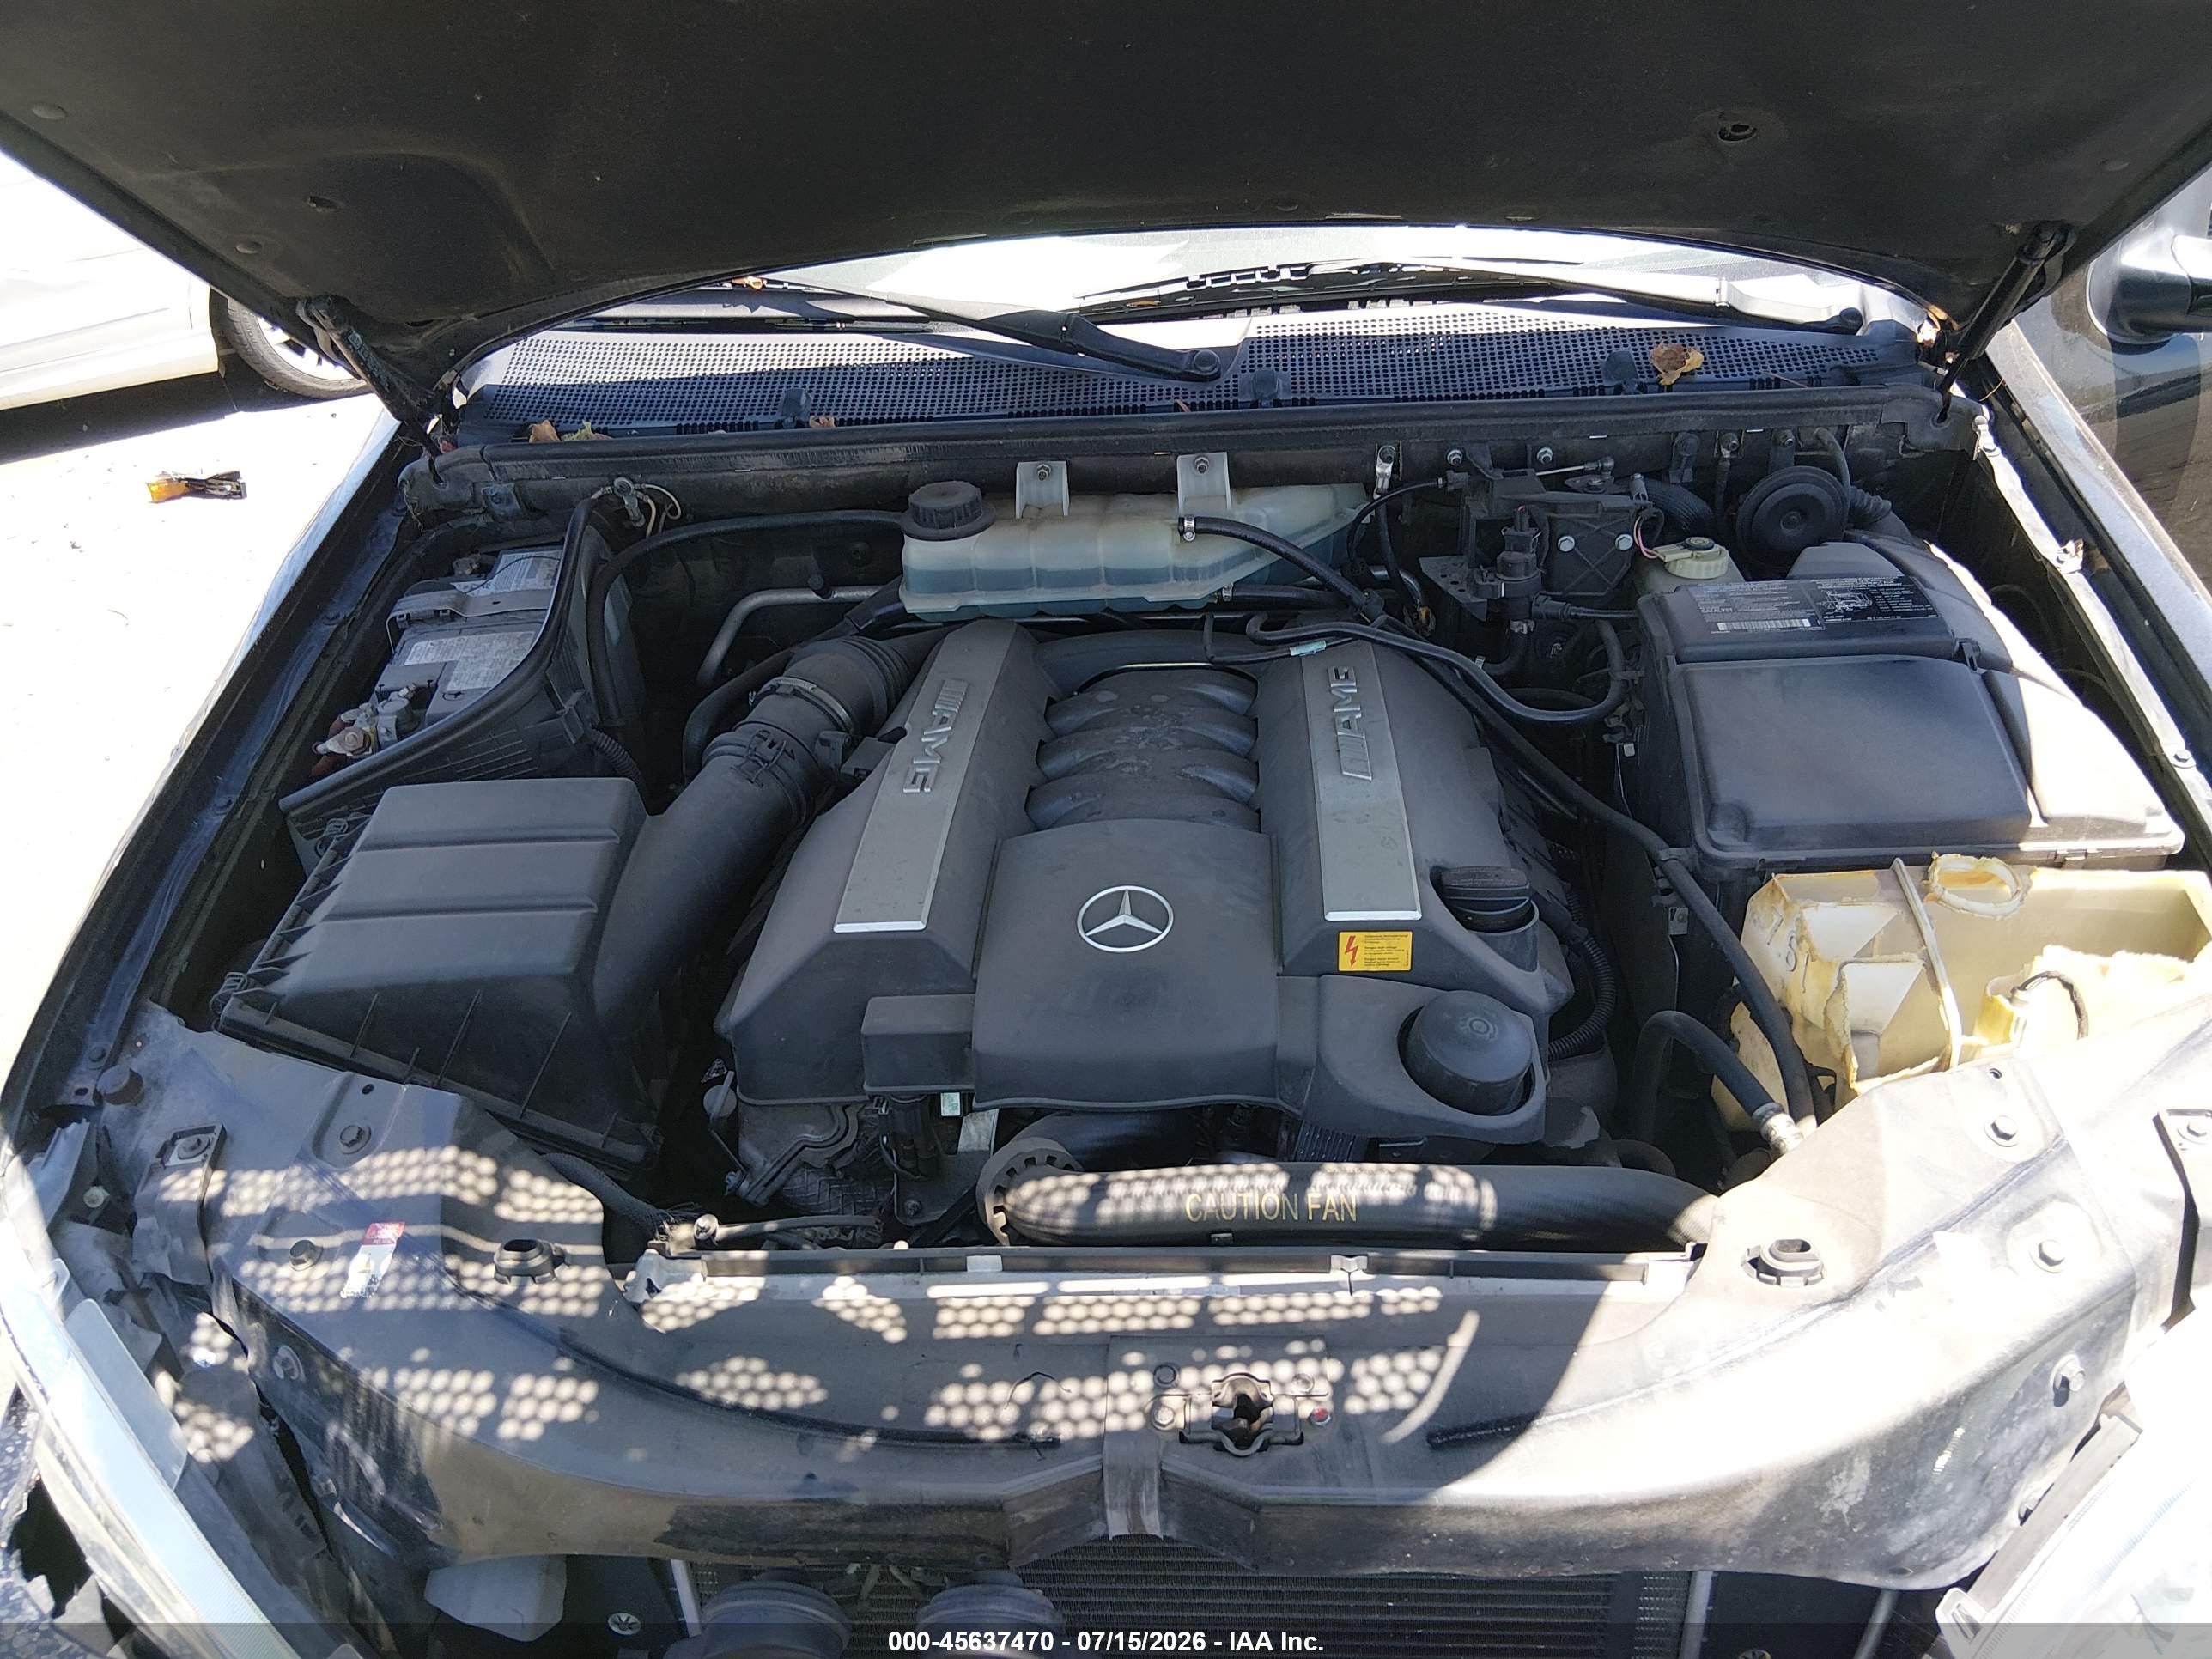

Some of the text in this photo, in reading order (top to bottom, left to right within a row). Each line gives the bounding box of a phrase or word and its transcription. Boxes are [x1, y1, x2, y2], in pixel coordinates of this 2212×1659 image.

[1328, 665, 1364, 739] AMG
[902, 707, 959, 793] AMG
[1185, 1191, 1358, 1222] CAUTION FAN
